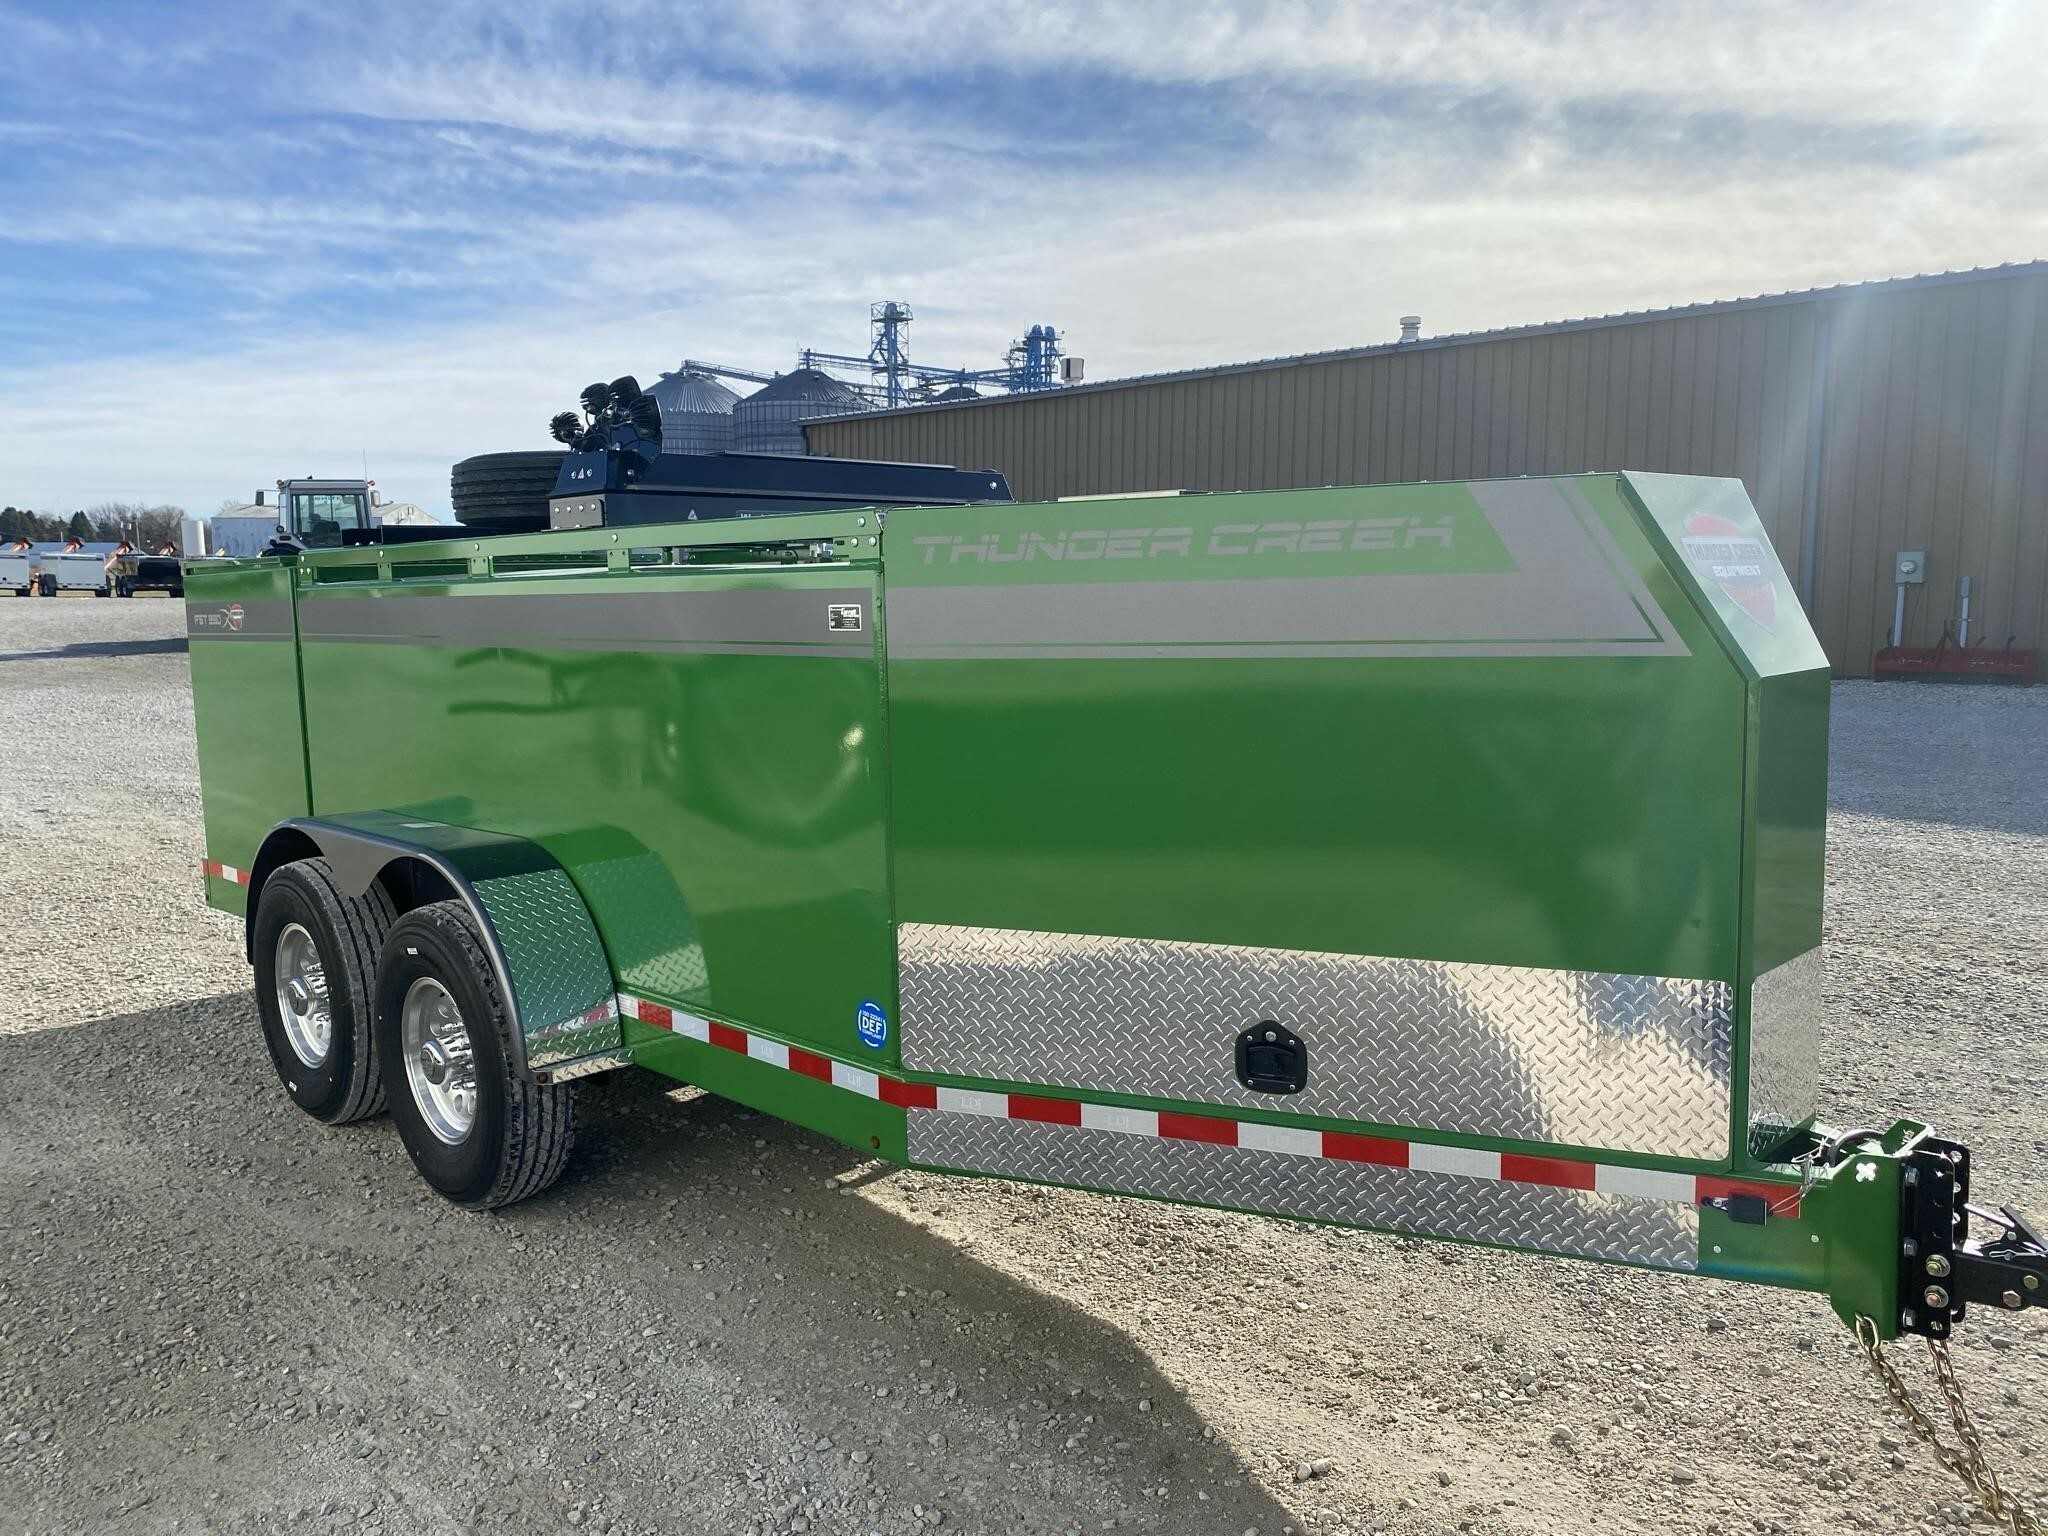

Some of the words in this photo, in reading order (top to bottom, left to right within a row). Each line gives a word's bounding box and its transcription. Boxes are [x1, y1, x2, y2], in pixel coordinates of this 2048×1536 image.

[913, 526, 1193, 564] THUNDER
[1207, 515, 1456, 555] CREEK
[1712, 564, 1761, 578] EQUIPMENT
[862, 1016, 882, 1034] DEF
